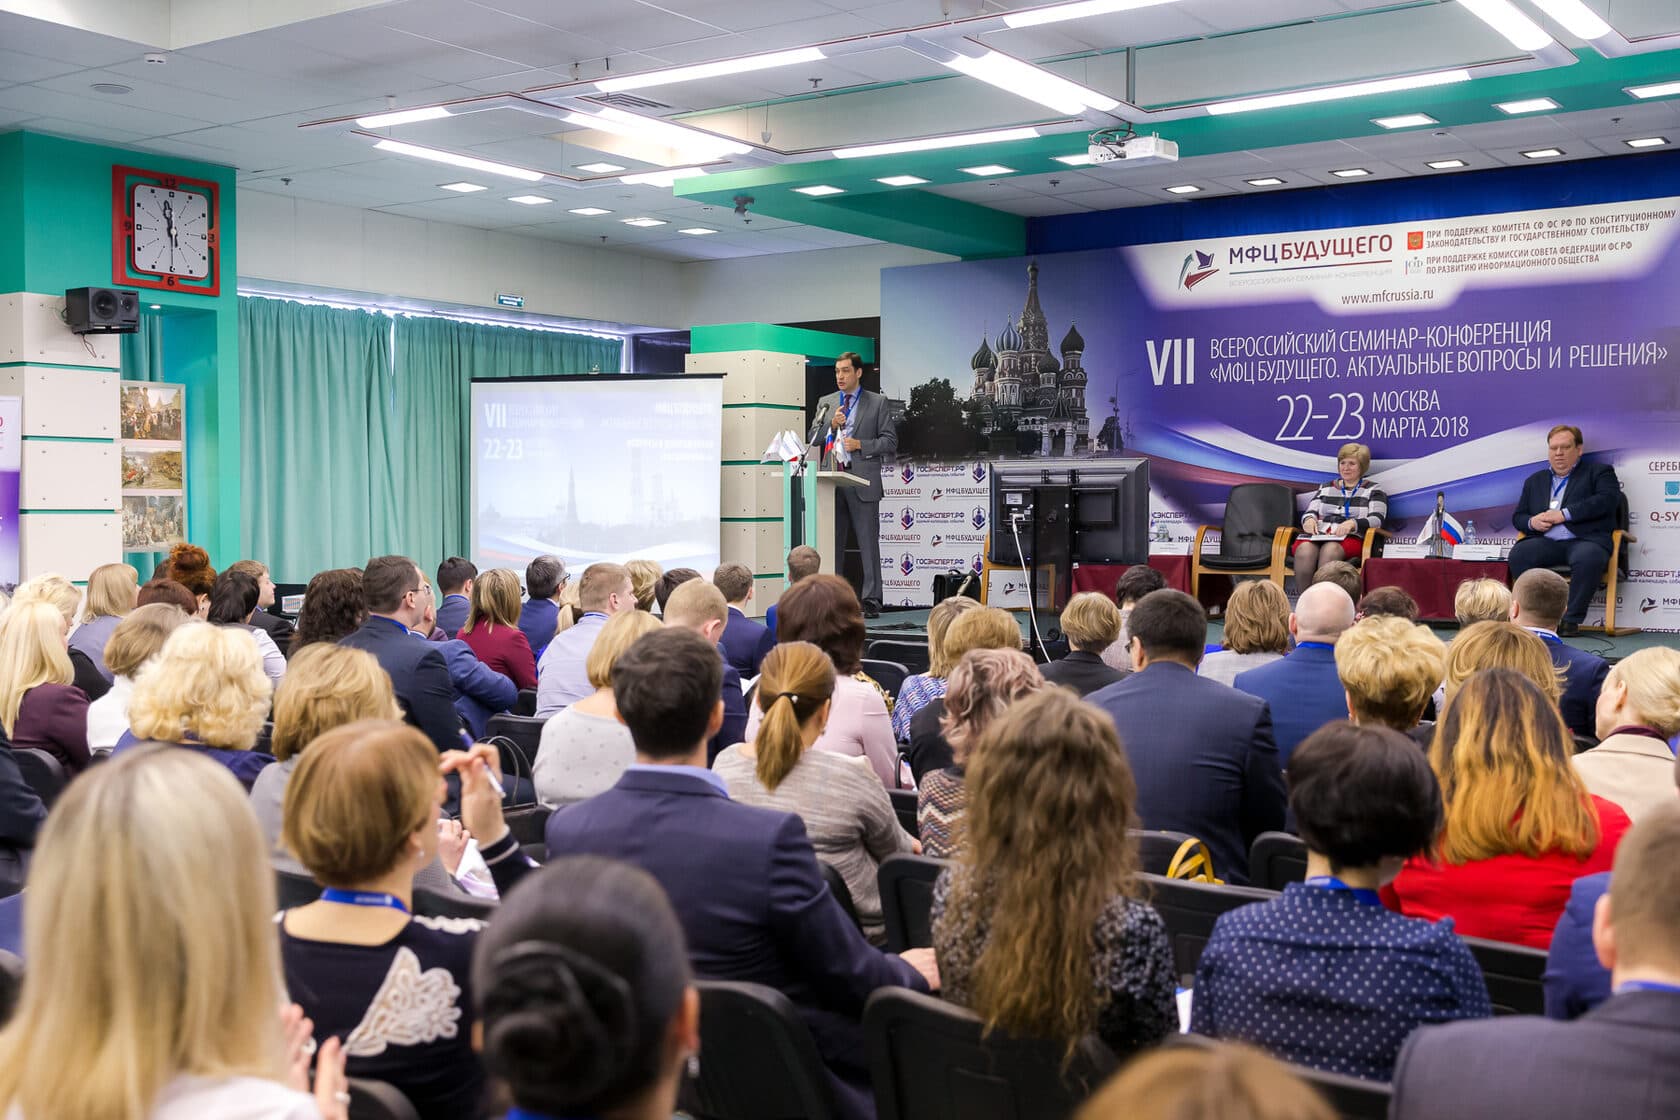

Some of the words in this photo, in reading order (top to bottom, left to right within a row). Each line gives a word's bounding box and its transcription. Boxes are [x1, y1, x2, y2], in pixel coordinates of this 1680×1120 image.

[1426, 230, 1441, 239] ПРИ
[1444, 225, 1489, 238] ПОДДЕРЖКЕ
[1491, 222, 1530, 233] КОМИТЕТА
[1561, 218, 1572, 228] РФ
[1575, 217, 1587, 226] ПО
[1589, 209, 1677, 225] КОНСТИТУЦИОННОМУ
[208, 233, 215, 243] 3
[1426, 235, 1499, 249] ЗАКОНОДАТЕЛЬСТВУ
[1500, 235, 1506, 243] И
[1509, 228, 1588, 242] ГОСУДАРСТВЕННОМУ
[1426, 256, 1441, 265] ПРИ
[1442, 252, 1488, 264] ПОДДЕРЖКЕ
[1488, 248, 1529, 260] КОМИССИИ
[1530, 247, 1558, 257] СОВЕТА
[1559, 242, 1606, 255] ФЕДЕРАЦИИ
[1620, 241, 1633, 250] РФ
[1426, 266, 1436, 274] ПО
[1437, 263, 1478, 274] РАЗВИТИЮ
[1478, 257, 1557, 271] ИНФОРМАЦИОННОГО
[1557, 254, 1600, 265] ОБЩЕСТВА
[167, 276, 175, 286] 6
[1341, 288, 1434, 305] www.mfcrussia.ru
[1210, 328, 1336, 359] ВСЕРОССИЙСКИЙ
[1339, 319, 1552, 354] СЕМИНАР-КОНФЕРЕНЦИЯ
[1145, 337, 1195, 386] VII
[1209, 361, 1255, 384] «МФЦ
[1257, 356, 1341, 384] БУДУЩЕГО.
[1346, 351, 1454, 378] АКТУАЛЬНЫЕ
[1456, 348, 1542, 374] ВОПРОСЫ
[1549, 346, 1562, 369] И
[1569, 341, 1669, 368] РЕШЕНИЯ»
[1372, 388, 1441, 413] МОСКВА
[484, 402, 507, 428] VII
[1372, 416, 1427, 439] МАРТА
[1430, 415, 1469, 438] 2018
[1648, 461, 1680, 472] СЕРЕБ
[945, 487, 990, 495] МФЦБУДУЩЕГ
[1650, 511, 1680, 522] Q-SY
